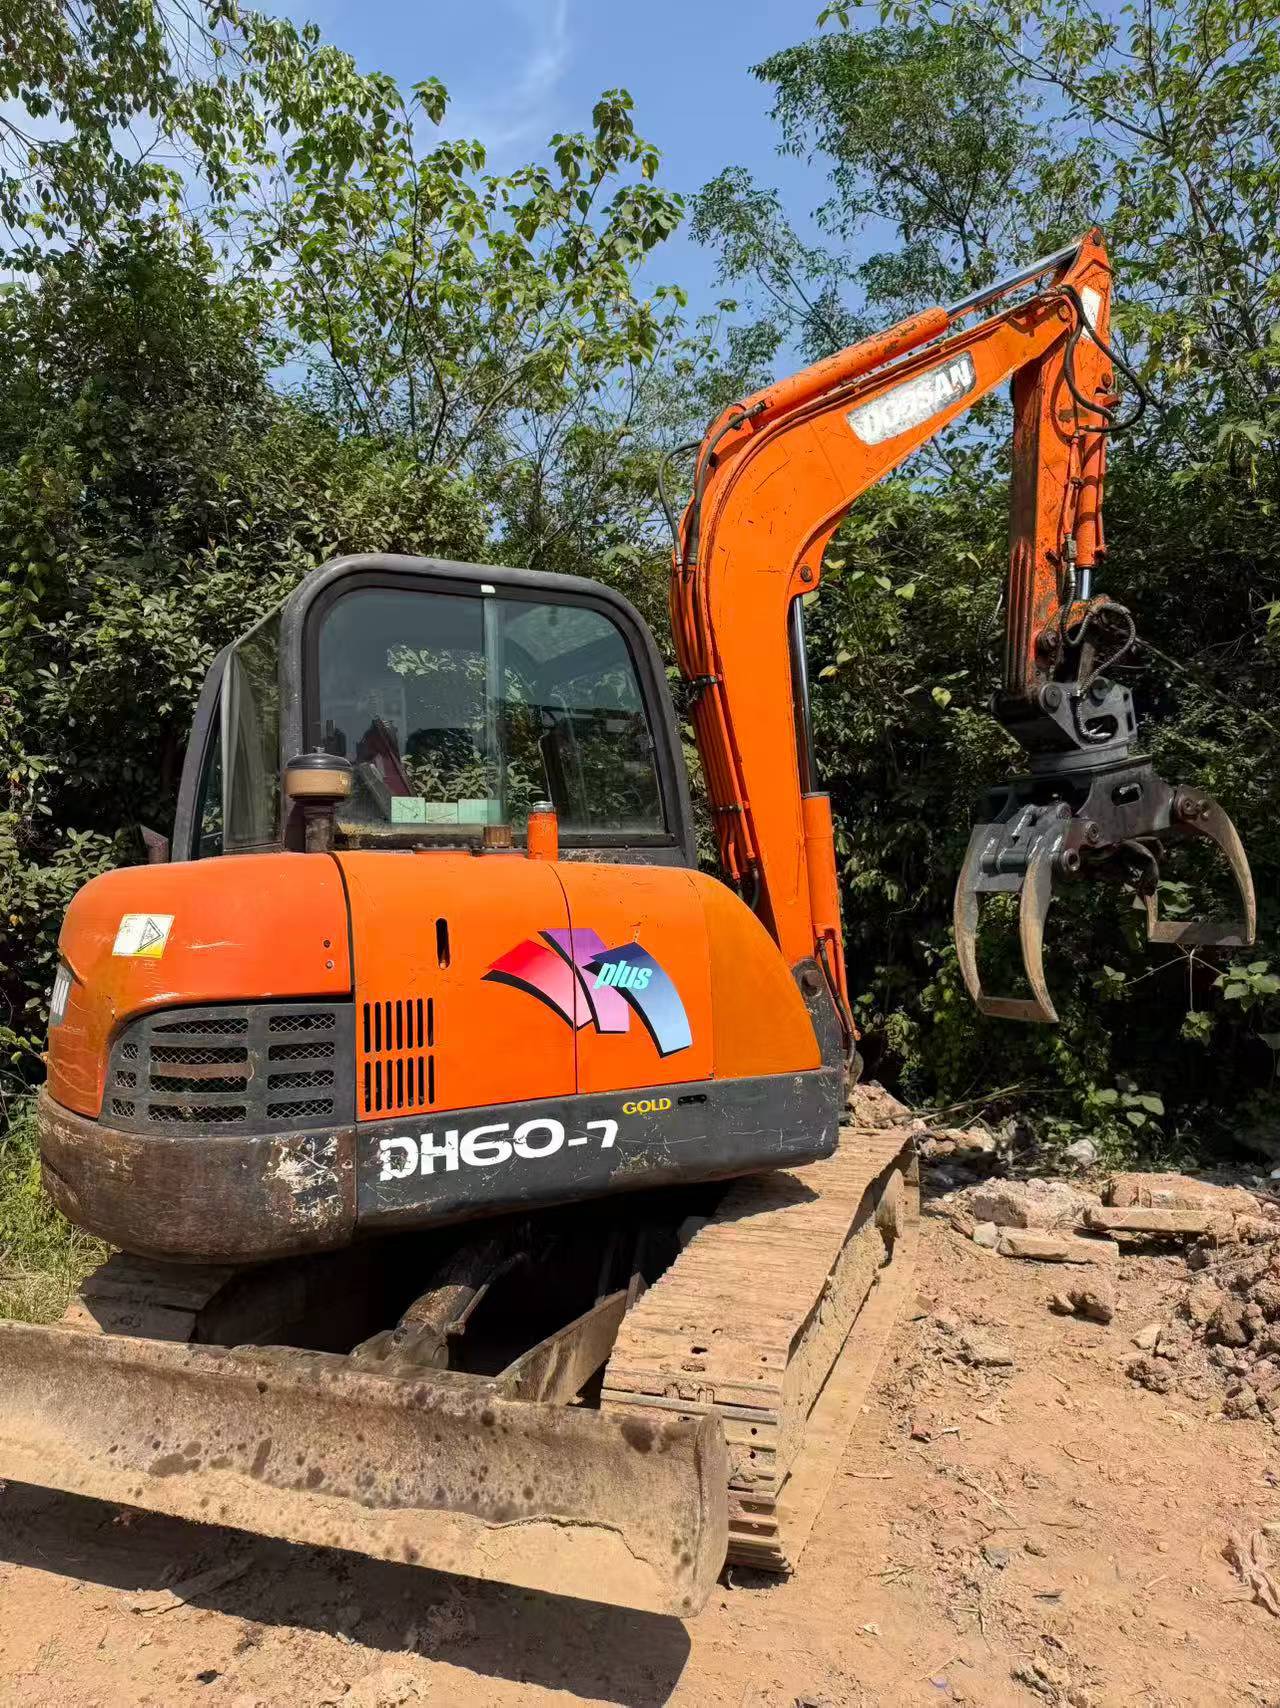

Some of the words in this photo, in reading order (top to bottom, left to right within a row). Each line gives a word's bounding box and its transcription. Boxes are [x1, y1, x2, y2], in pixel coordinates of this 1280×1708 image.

[593, 960, 653, 989] plus
[622, 1098, 671, 1115] GOLD
[379, 1118, 618, 1182] DH60-7
